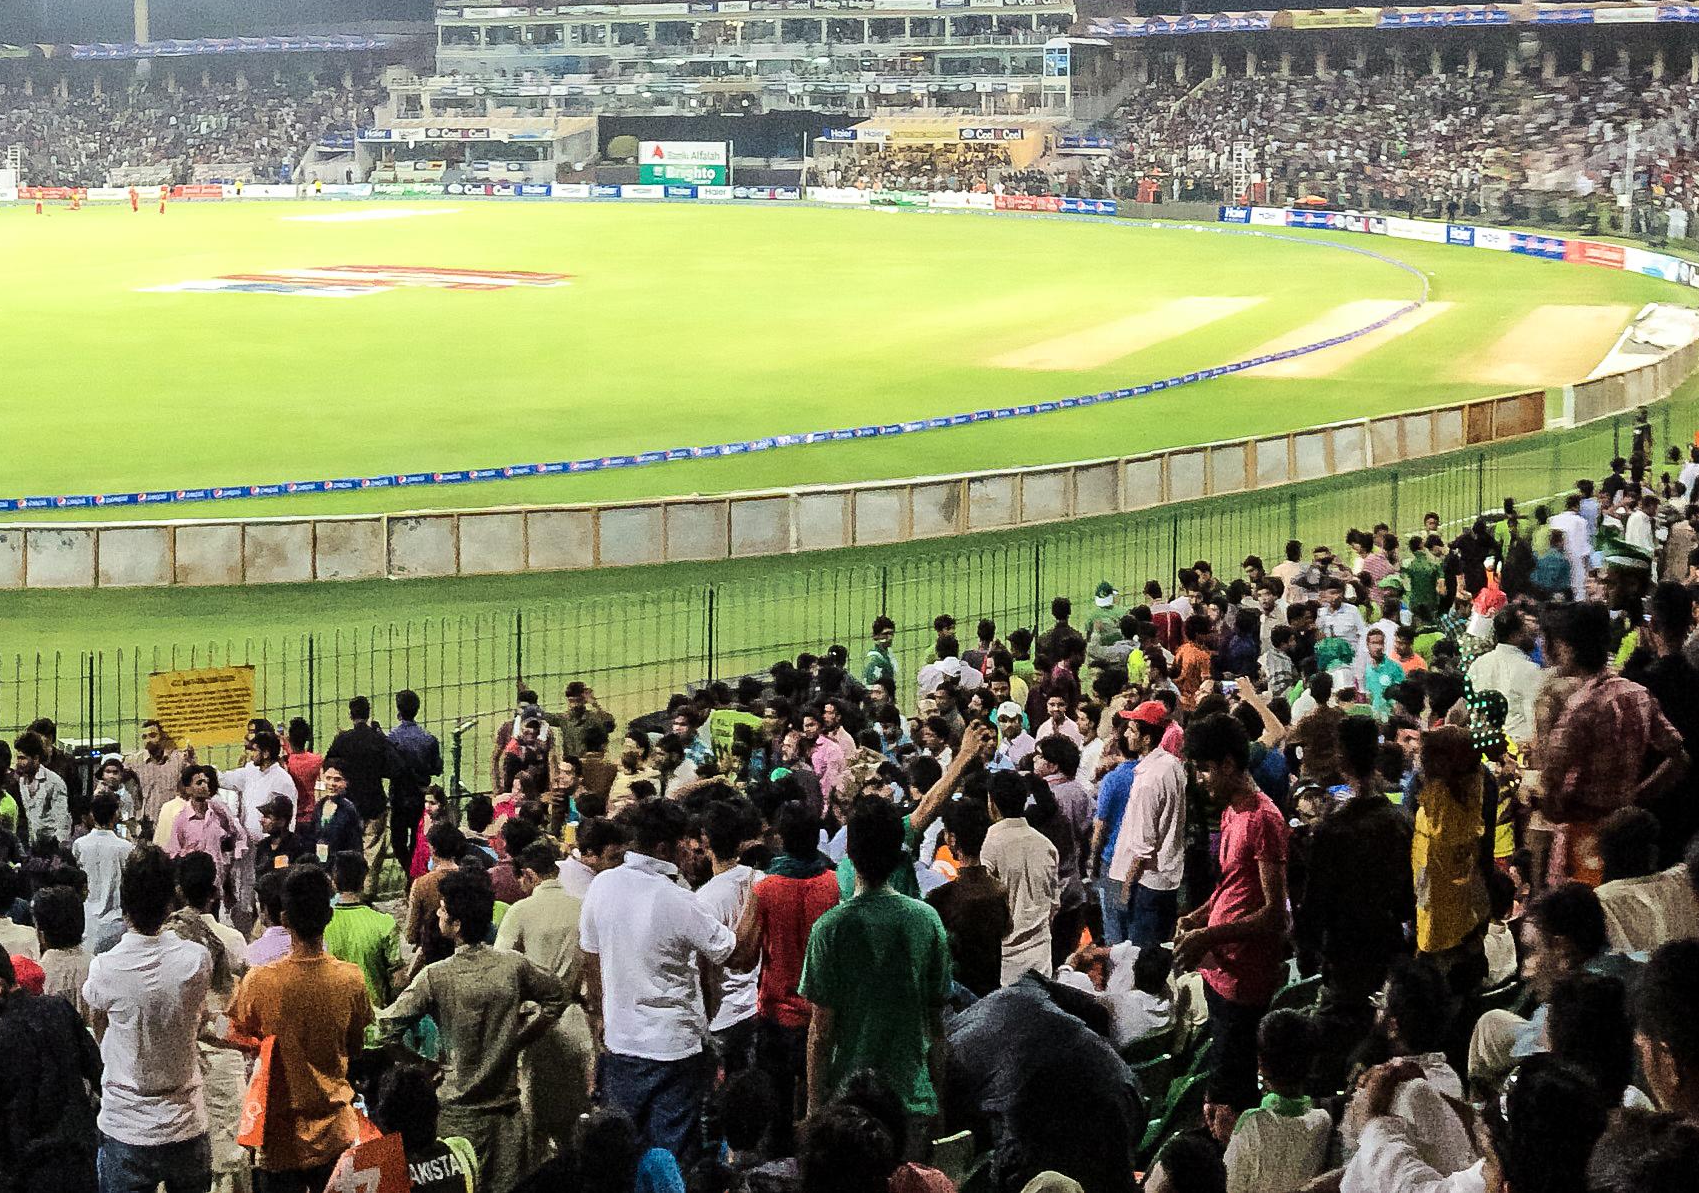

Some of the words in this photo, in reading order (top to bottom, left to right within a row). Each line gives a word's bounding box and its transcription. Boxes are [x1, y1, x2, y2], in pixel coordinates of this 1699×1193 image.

[830, 128, 853, 138] Haier
[975, 128, 995, 140] Cool
[1002, 128, 1022, 140] Cool
[665, 164, 716, 182] Brighto
[704, 187, 727, 196] Haier
